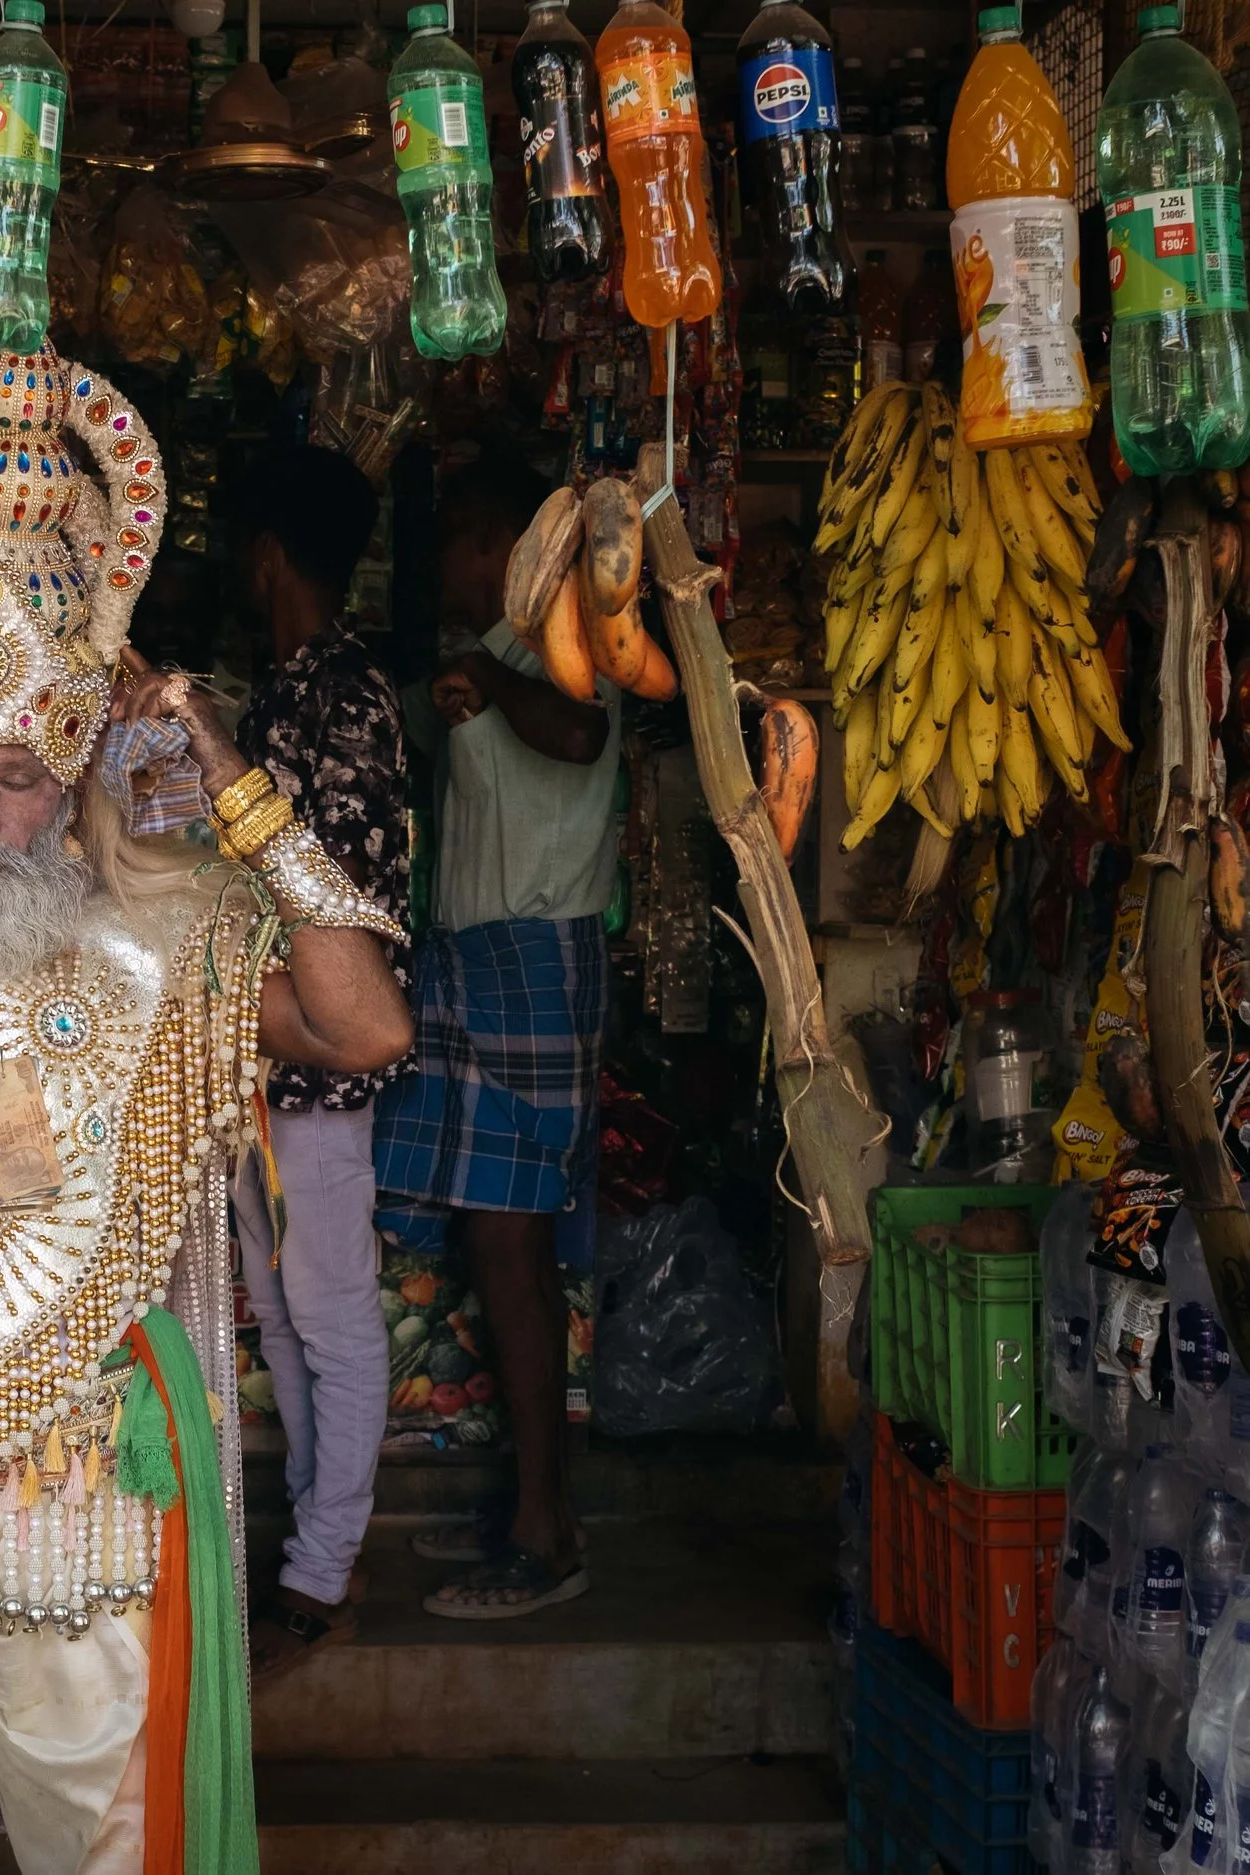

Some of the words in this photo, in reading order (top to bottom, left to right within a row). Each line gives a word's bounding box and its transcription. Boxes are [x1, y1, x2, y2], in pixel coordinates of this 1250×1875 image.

[757, 85, 807, 105] PEPSI
[1161, 238, 1189, 251] ₹90/-
[1087, 1152, 1111, 1164] SALT
[995, 1339, 1024, 1380] R
[996, 1402, 1024, 1442] K
[1147, 1577, 1182, 1589] MERIB
[1003, 1584, 1021, 1617] V
[1003, 1634, 1021, 1669] C
